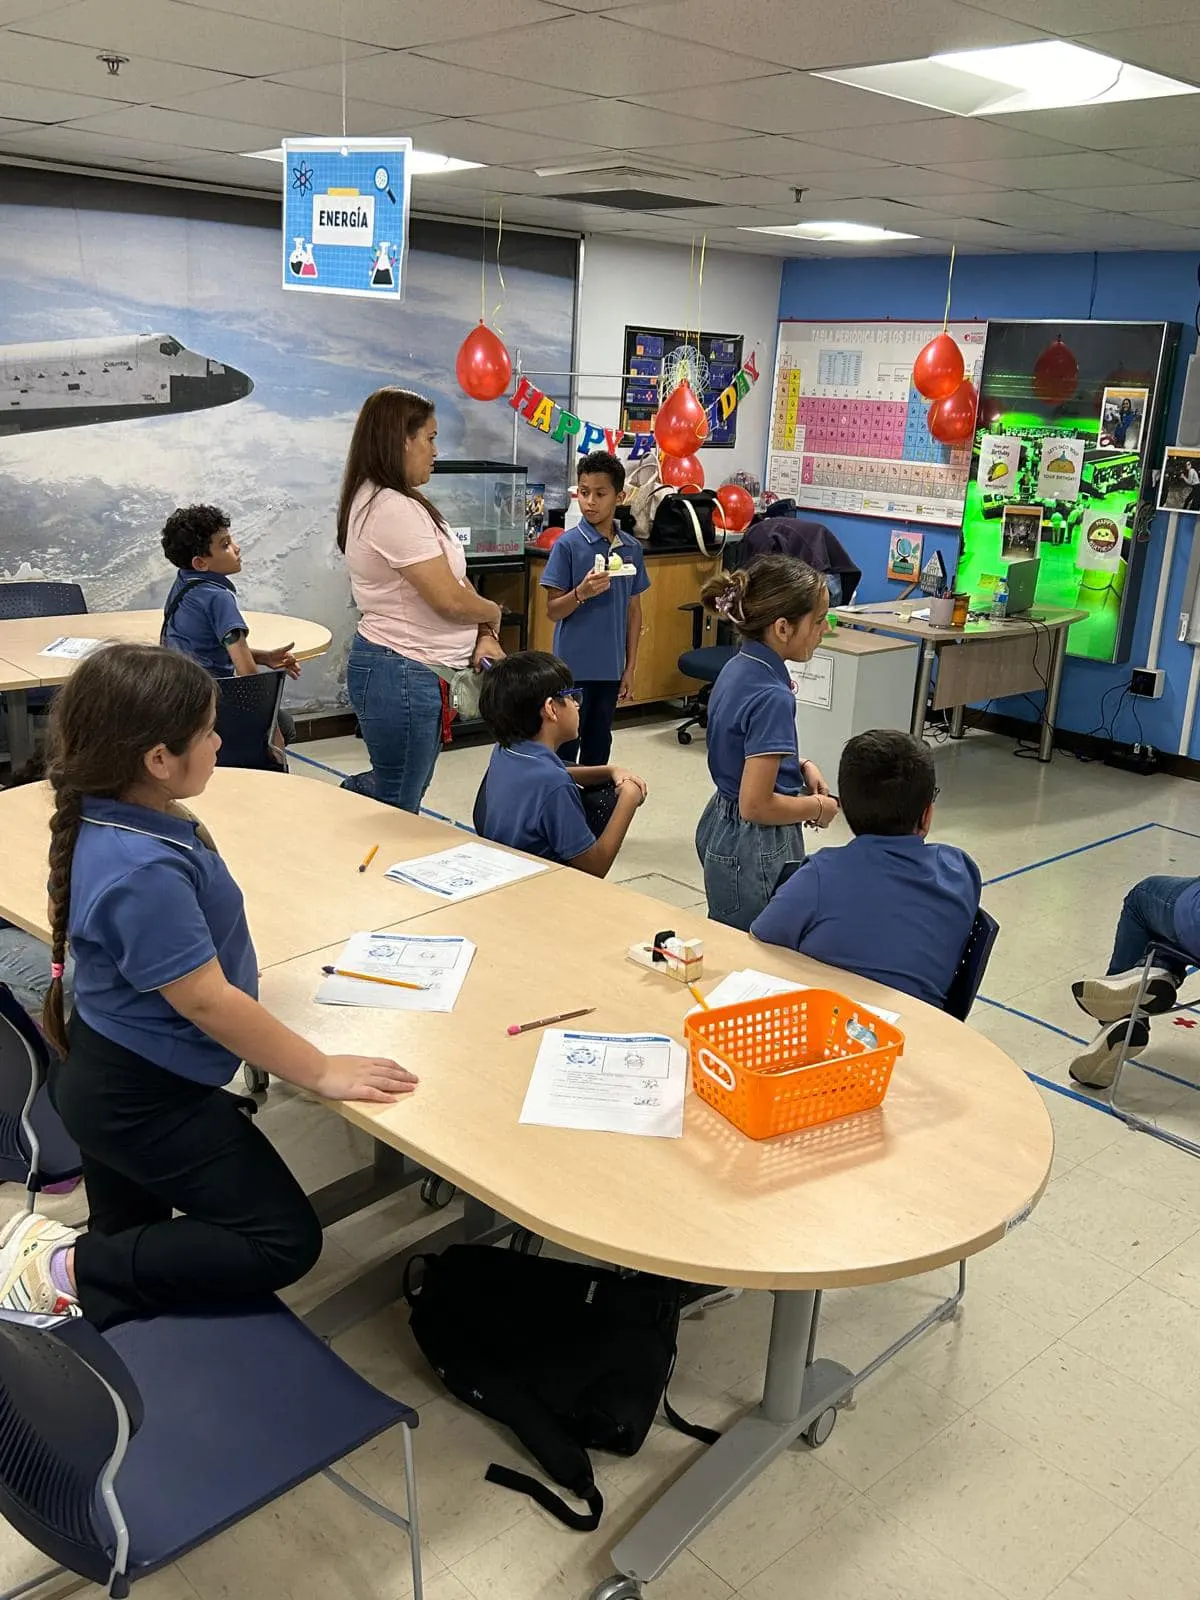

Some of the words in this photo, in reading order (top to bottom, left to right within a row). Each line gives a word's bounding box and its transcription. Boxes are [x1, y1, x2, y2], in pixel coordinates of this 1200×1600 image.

[319, 207, 369, 228] ENERGÍA
[811, 330, 834, 342] TABLA
[877, 331, 888, 344] DE
[889, 331, 904, 344] LOS
[508, 376, 625, 457] HAPPY
